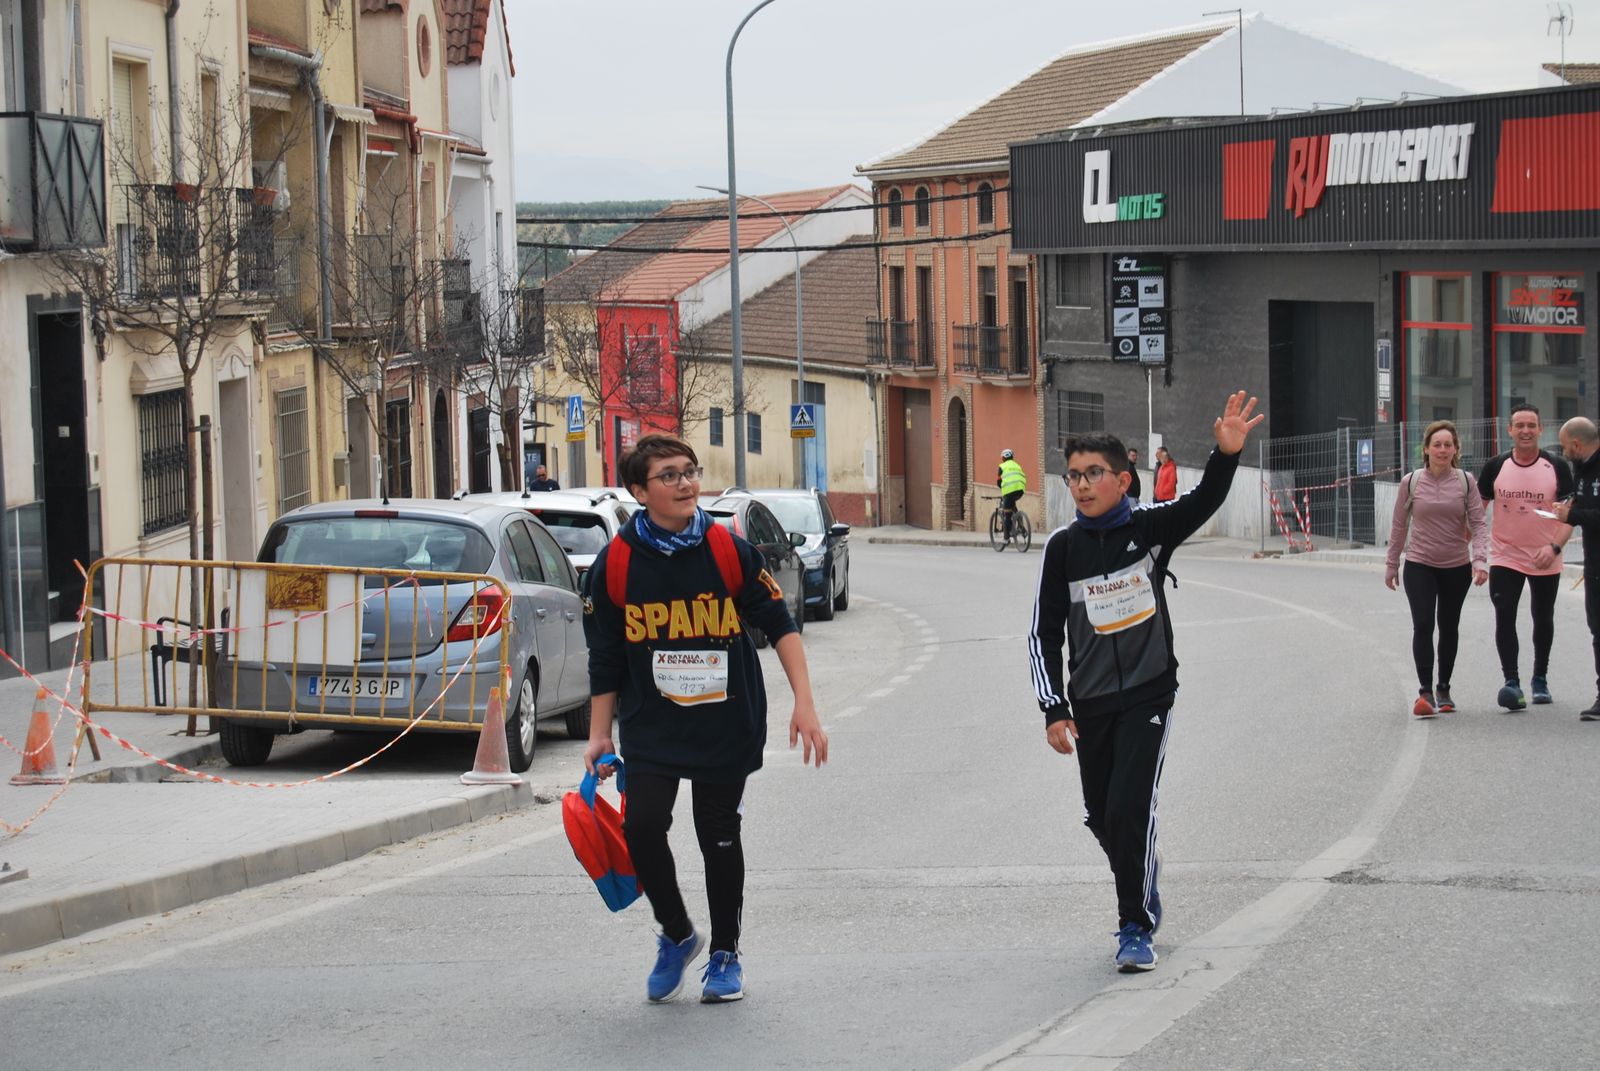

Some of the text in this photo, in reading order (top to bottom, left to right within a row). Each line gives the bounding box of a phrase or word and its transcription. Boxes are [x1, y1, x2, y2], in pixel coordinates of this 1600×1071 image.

[1325, 122, 1475, 186] MOTORSPORT
[1118, 192, 1164, 221] MOTOS
[624, 592, 741, 642] SPAÑA
[368, 679, 400, 696] GJP
